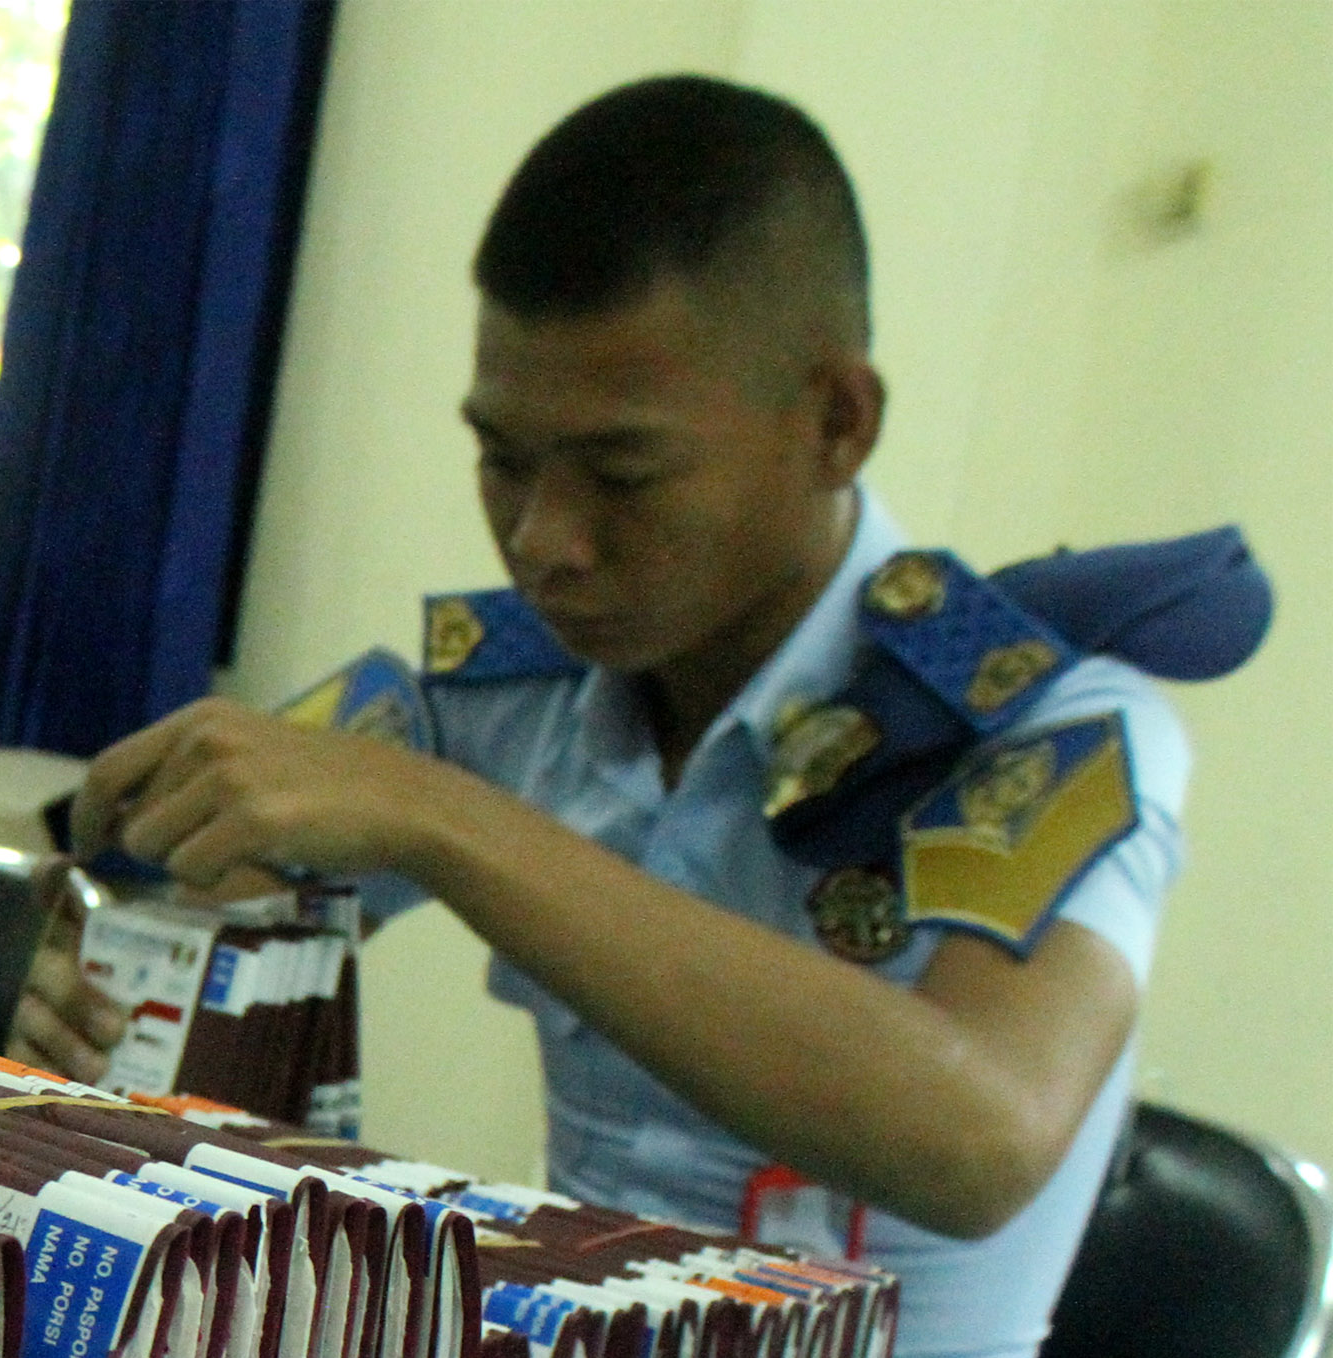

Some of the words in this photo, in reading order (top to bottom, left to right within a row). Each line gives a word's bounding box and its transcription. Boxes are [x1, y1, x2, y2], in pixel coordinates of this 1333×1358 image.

[29, 1223, 64, 1285] NAMA
[66, 1235, 92, 1270] NO.
[93, 1245, 120, 1280] NO.
[43, 1280, 76, 1348] PORSI
